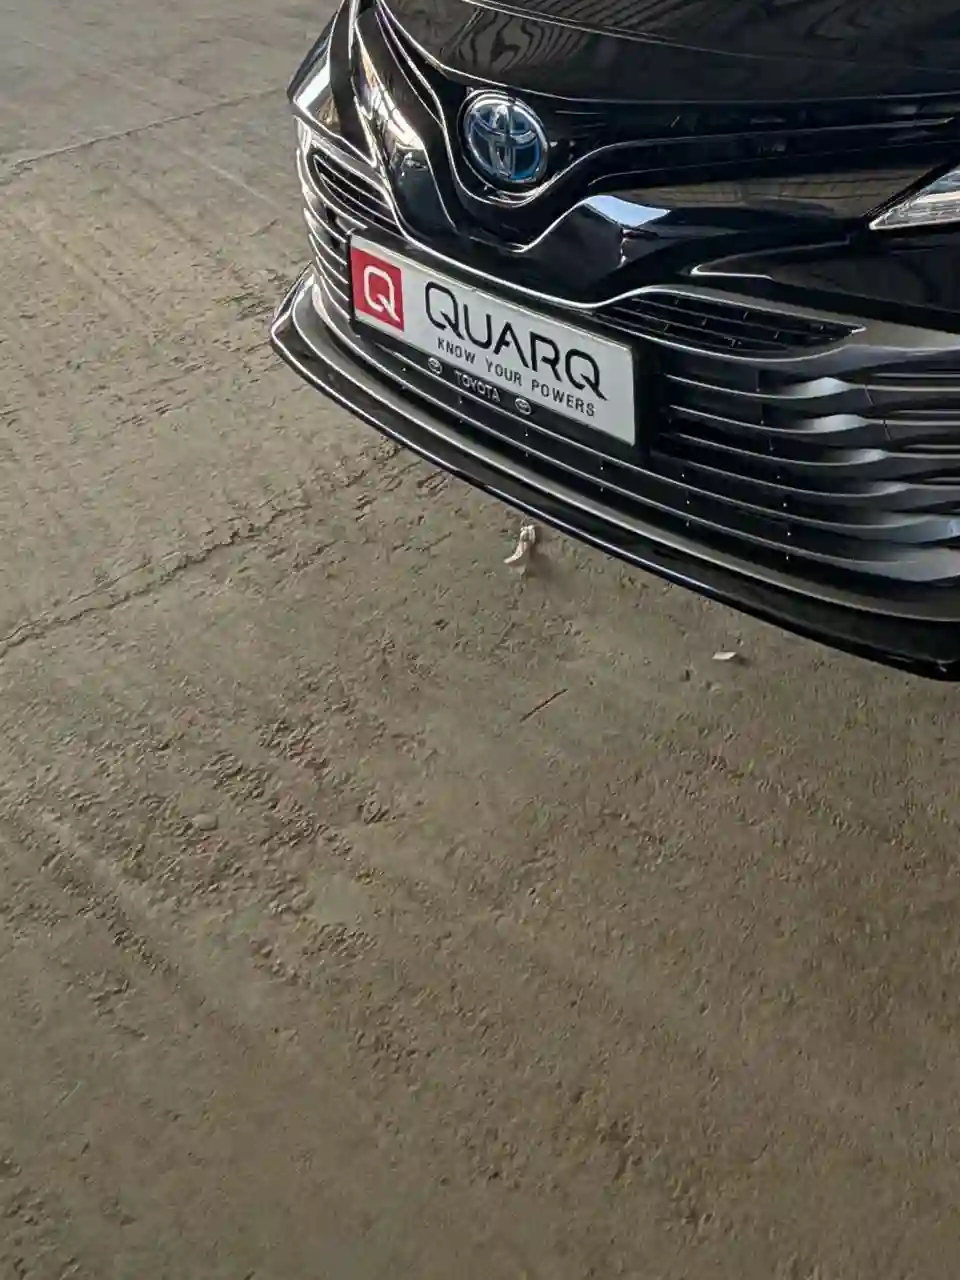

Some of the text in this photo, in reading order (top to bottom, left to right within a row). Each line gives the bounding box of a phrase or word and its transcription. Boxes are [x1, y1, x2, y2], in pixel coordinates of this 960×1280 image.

[424, 281, 608, 401] QUARQ
[437, 336, 596, 418] KNOW YOUR POWERS
[453, 370, 501, 402] TOYOTA
